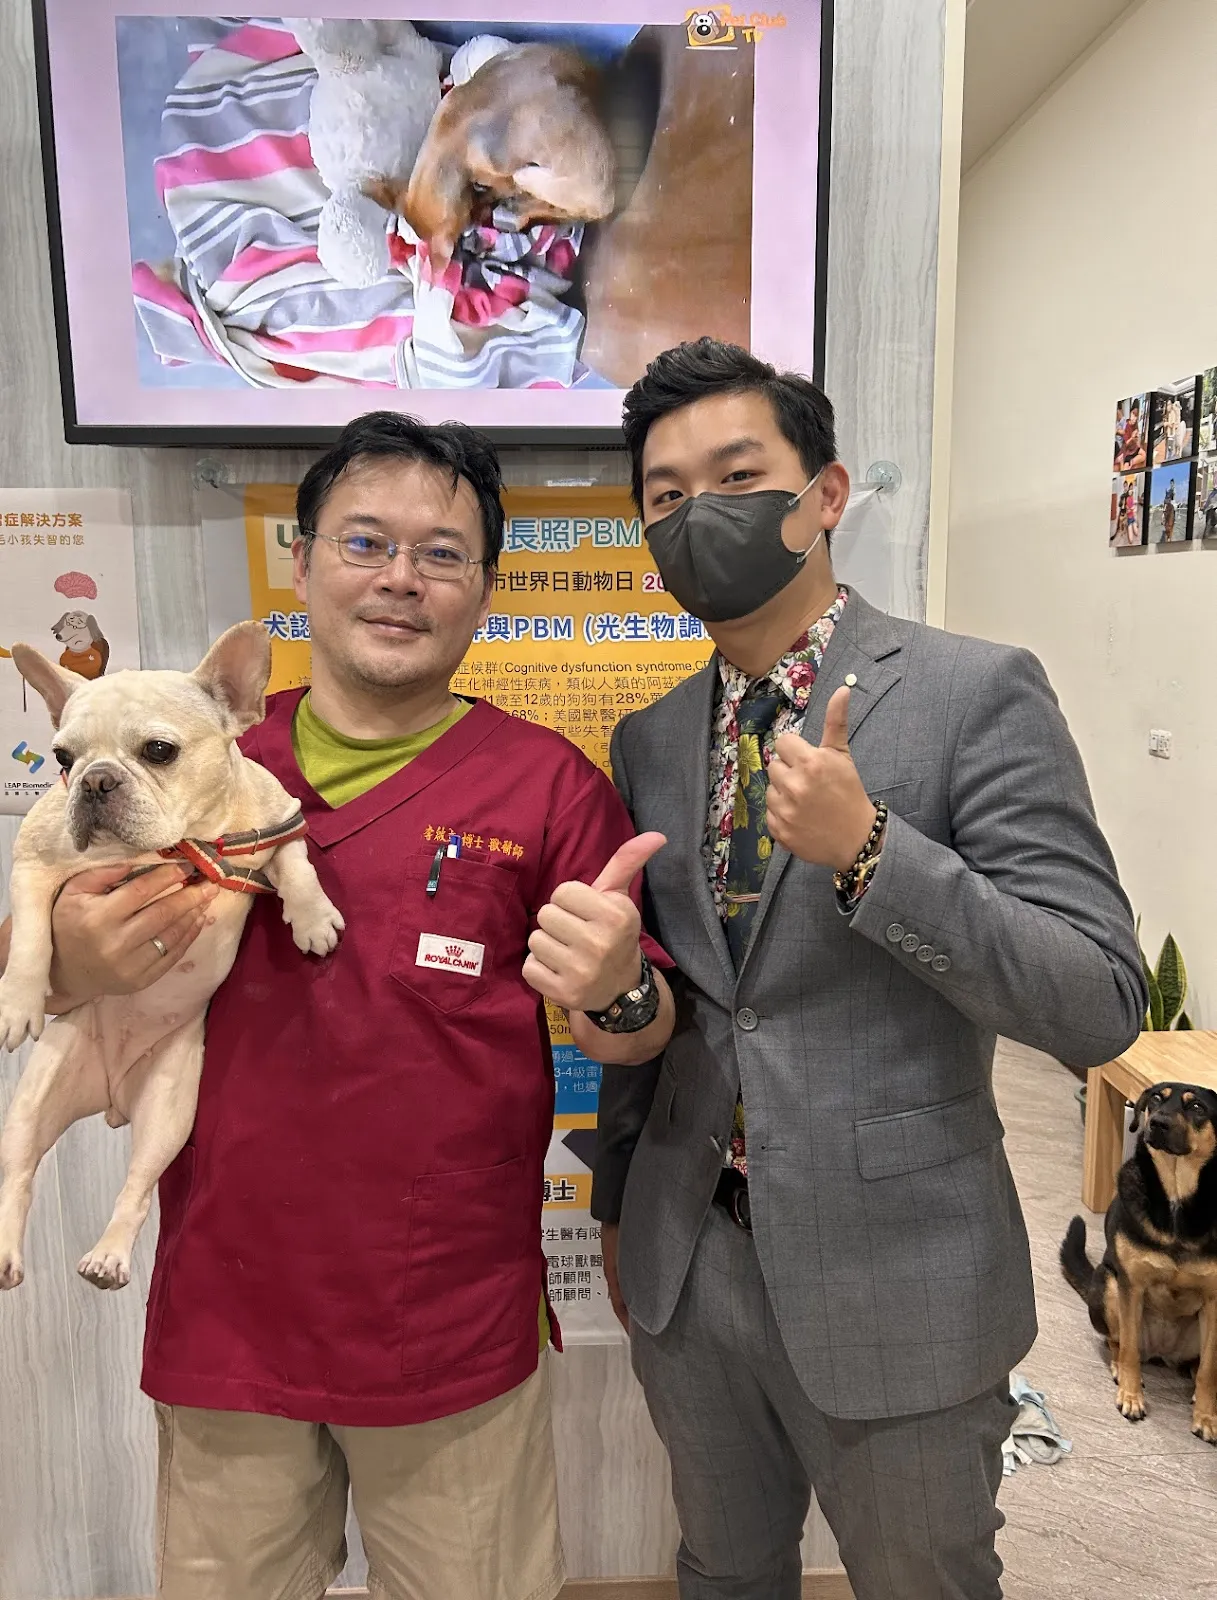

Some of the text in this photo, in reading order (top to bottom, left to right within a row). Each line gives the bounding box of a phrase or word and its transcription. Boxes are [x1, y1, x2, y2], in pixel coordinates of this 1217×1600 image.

[0, 512, 83, 527] 症解決方案
[501, 519, 641, 550] 長照PBM
[474, 615, 573, 640] 與PBM
[561, 661, 632, 674] dysfunction
[425, 954, 452, 966] ROYAL
